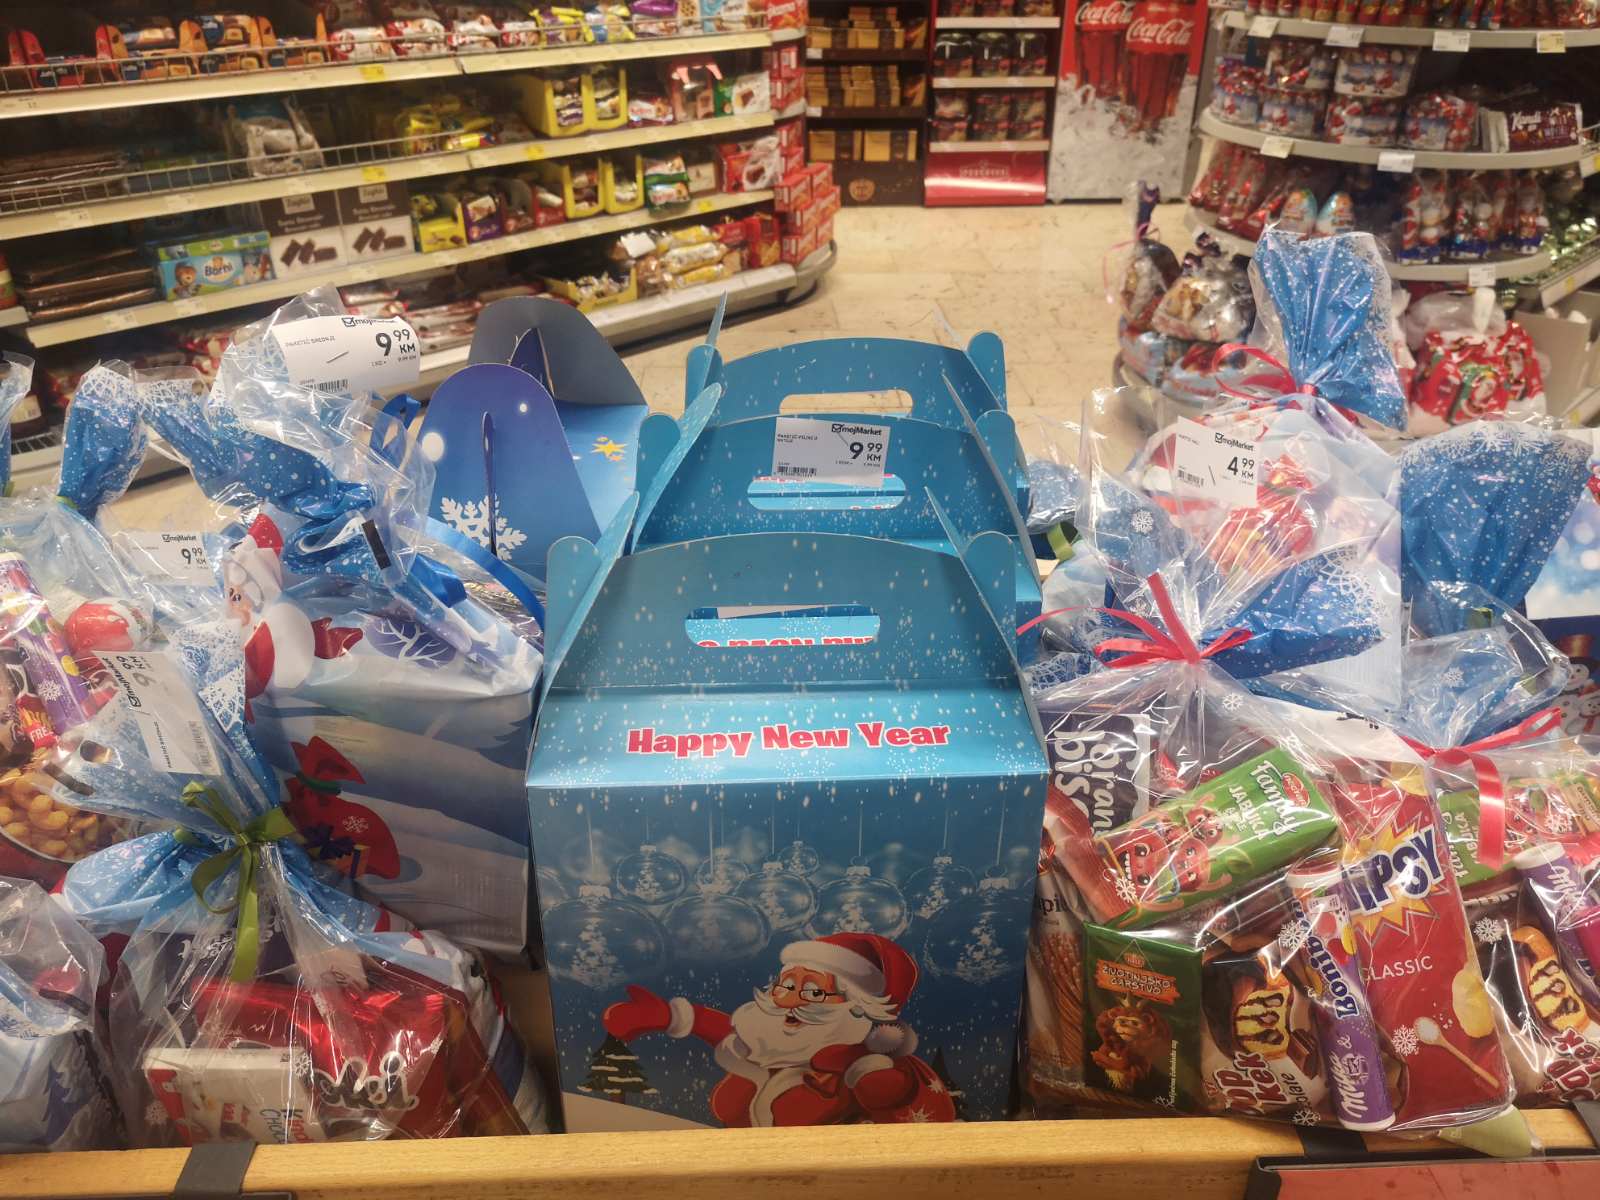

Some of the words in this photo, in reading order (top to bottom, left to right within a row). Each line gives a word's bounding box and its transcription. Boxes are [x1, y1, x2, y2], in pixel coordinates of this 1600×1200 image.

[375, 332, 392, 356] 9
[393, 329, 410, 342] 99
[399, 343, 416, 354] KM
[841, 424, 882, 436] mojMarket
[849, 442, 864, 459] 9
[867, 443, 882, 452] 99
[866, 454, 881, 462] KM
[1227, 456, 1238, 476] 4
[1241, 458, 1255, 469] 99
[1241, 470, 1254, 479] KM
[181, 548, 191, 564] 9
[192, 547, 202, 556] 99
[627, 727, 754, 759] Happy
[761, 723, 851, 751] New
[856, 720, 950, 748] Year
